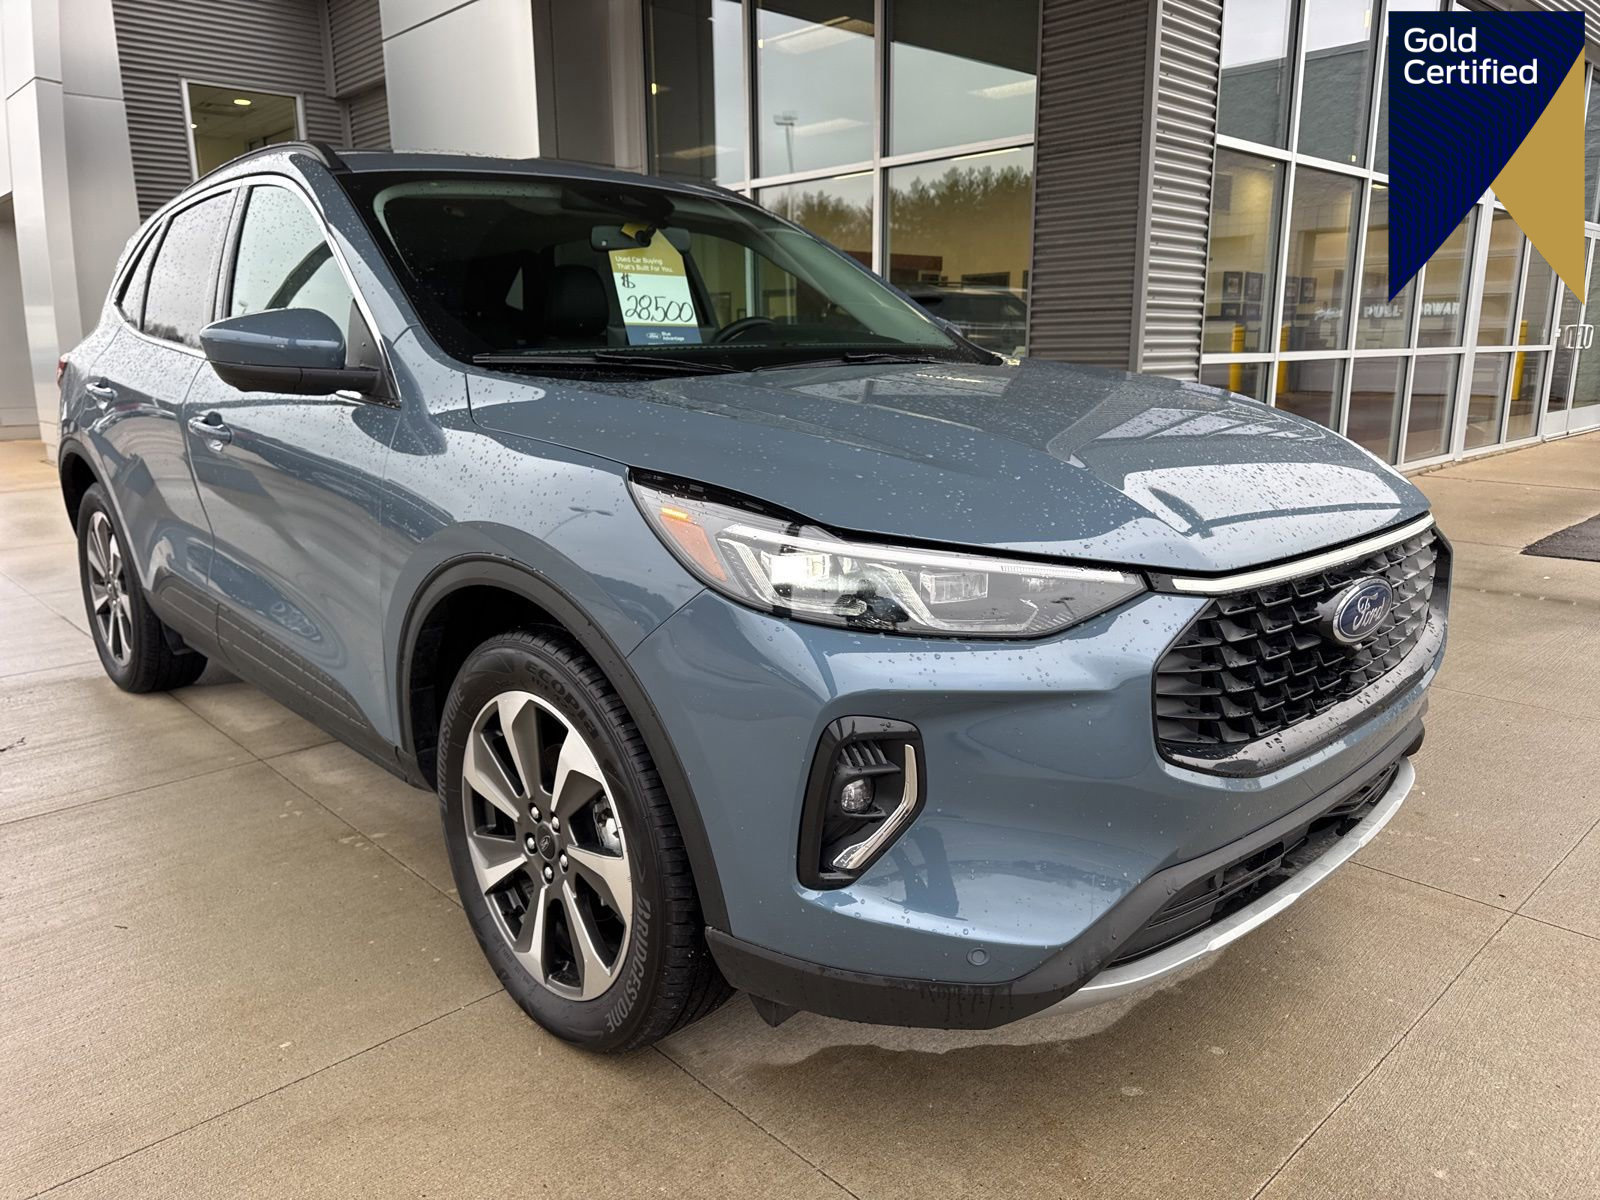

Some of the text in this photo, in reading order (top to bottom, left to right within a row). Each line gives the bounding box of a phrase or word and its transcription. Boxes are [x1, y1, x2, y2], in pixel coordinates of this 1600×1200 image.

[615, 255, 631, 263] Used
[643, 257, 663, 266] Buying
[625, 295, 694, 323] 28,500
[1353, 592, 1386, 631] Ford
[605, 891, 651, 1033] BRIDGESTONE
